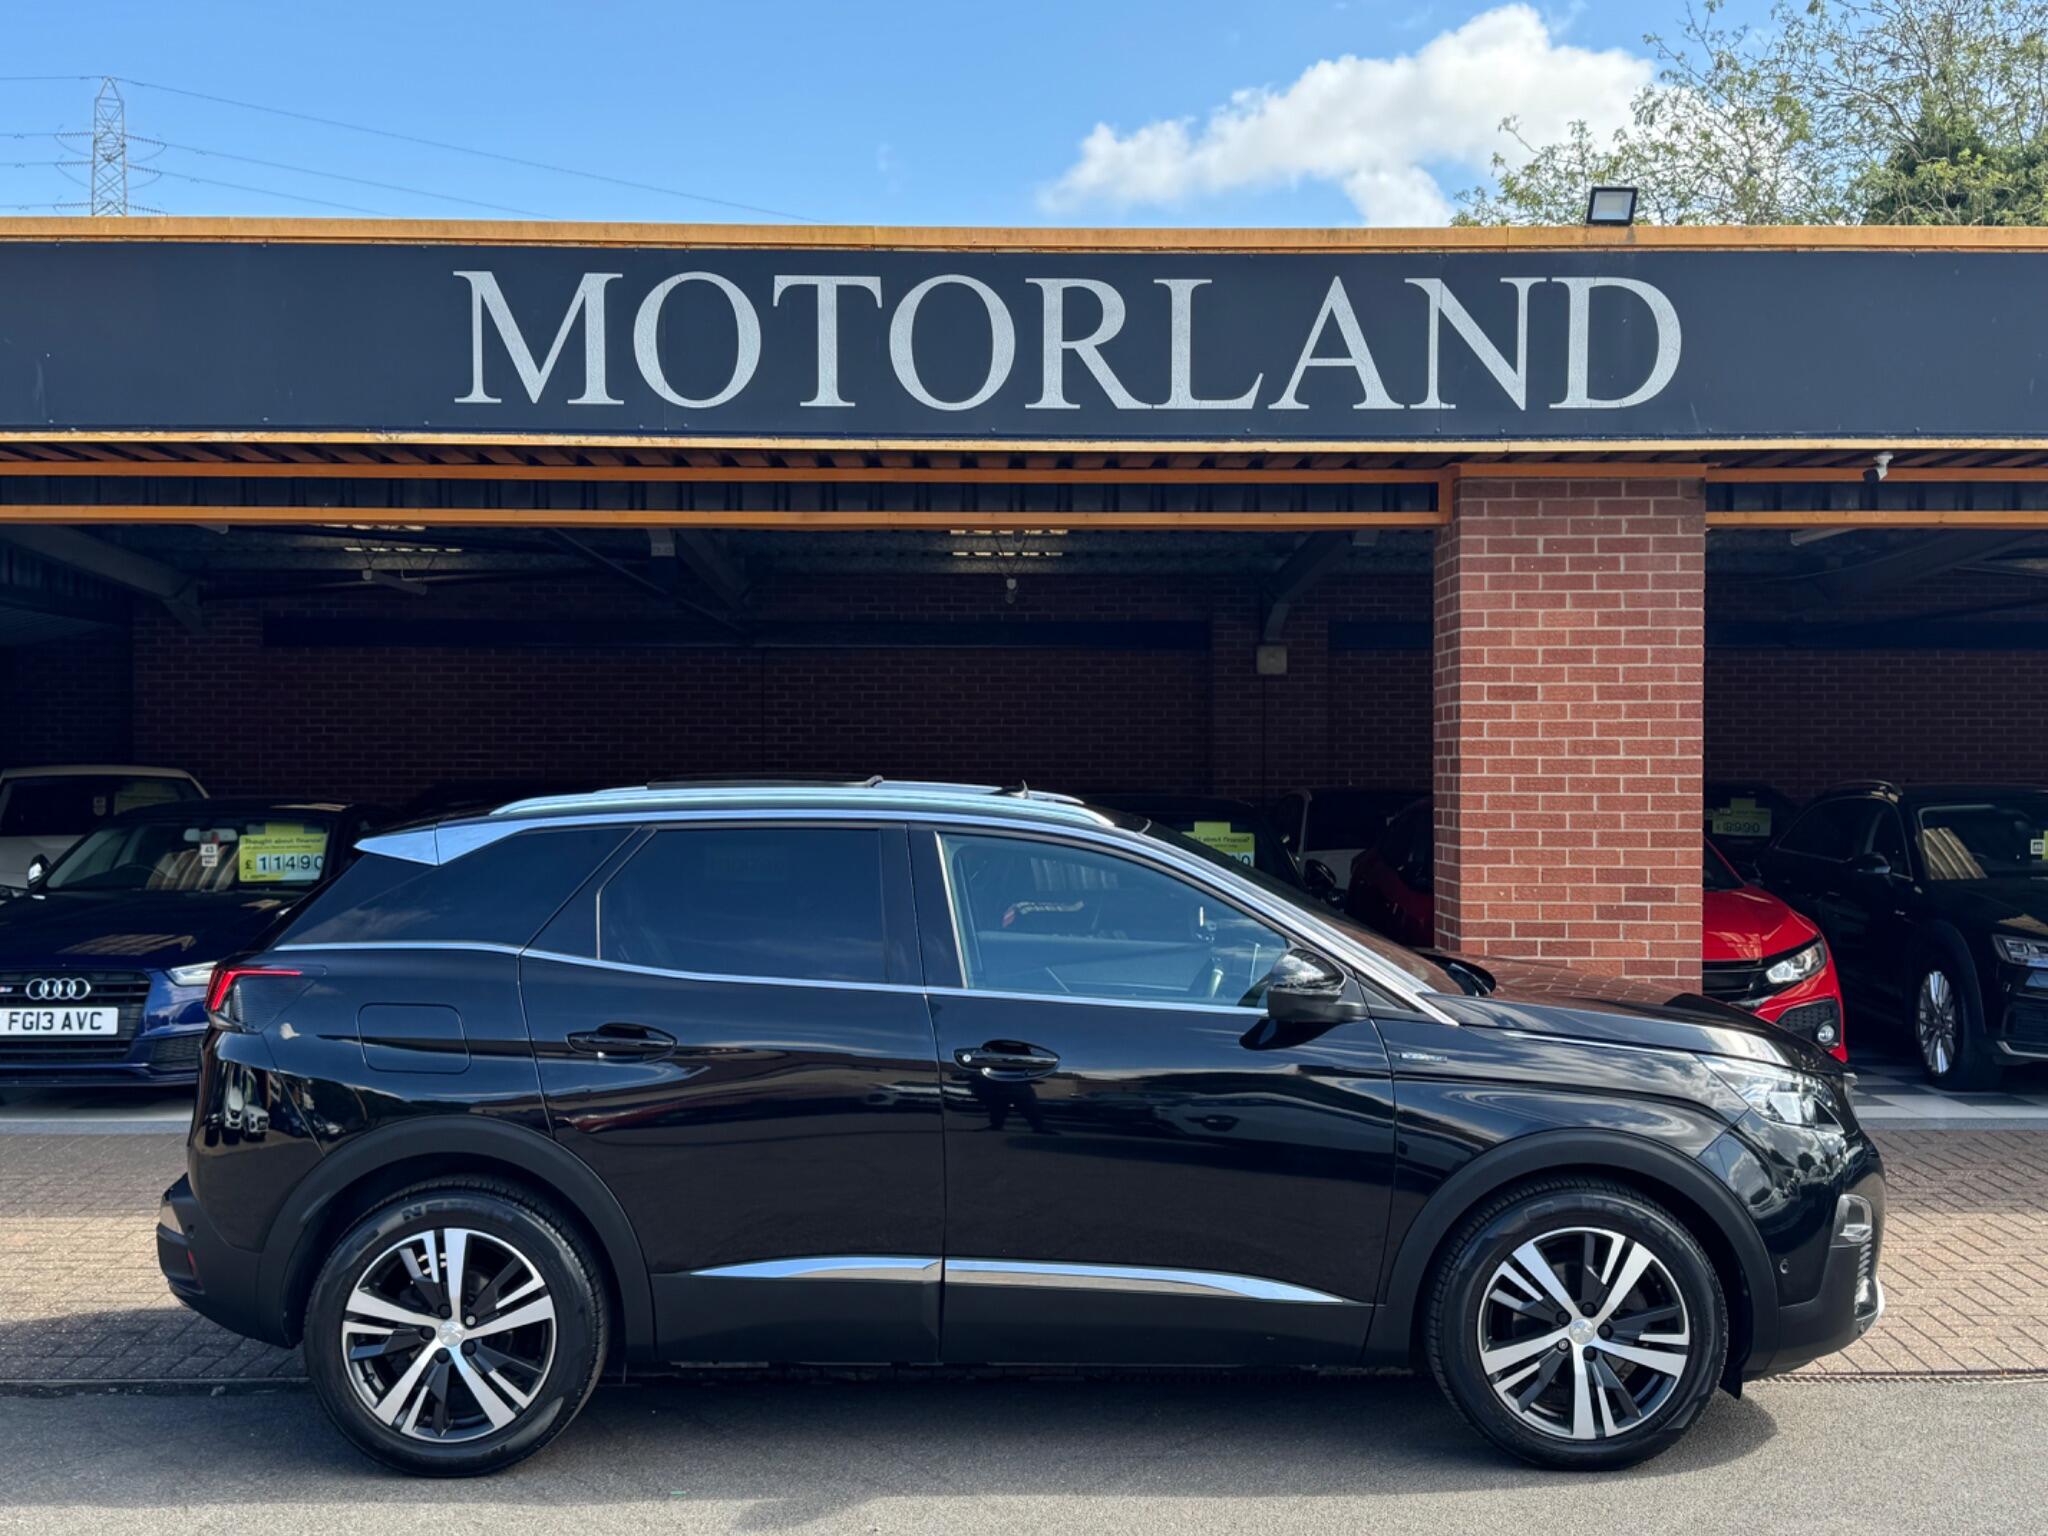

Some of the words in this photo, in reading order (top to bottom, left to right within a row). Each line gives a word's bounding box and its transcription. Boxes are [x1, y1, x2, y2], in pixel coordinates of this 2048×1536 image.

[453, 269, 1684, 413] MOTORLAND
[258, 855, 324, 870] 11490
[8, 1011, 54, 1031] FG13
[61, 1011, 103, 1031] AVC
